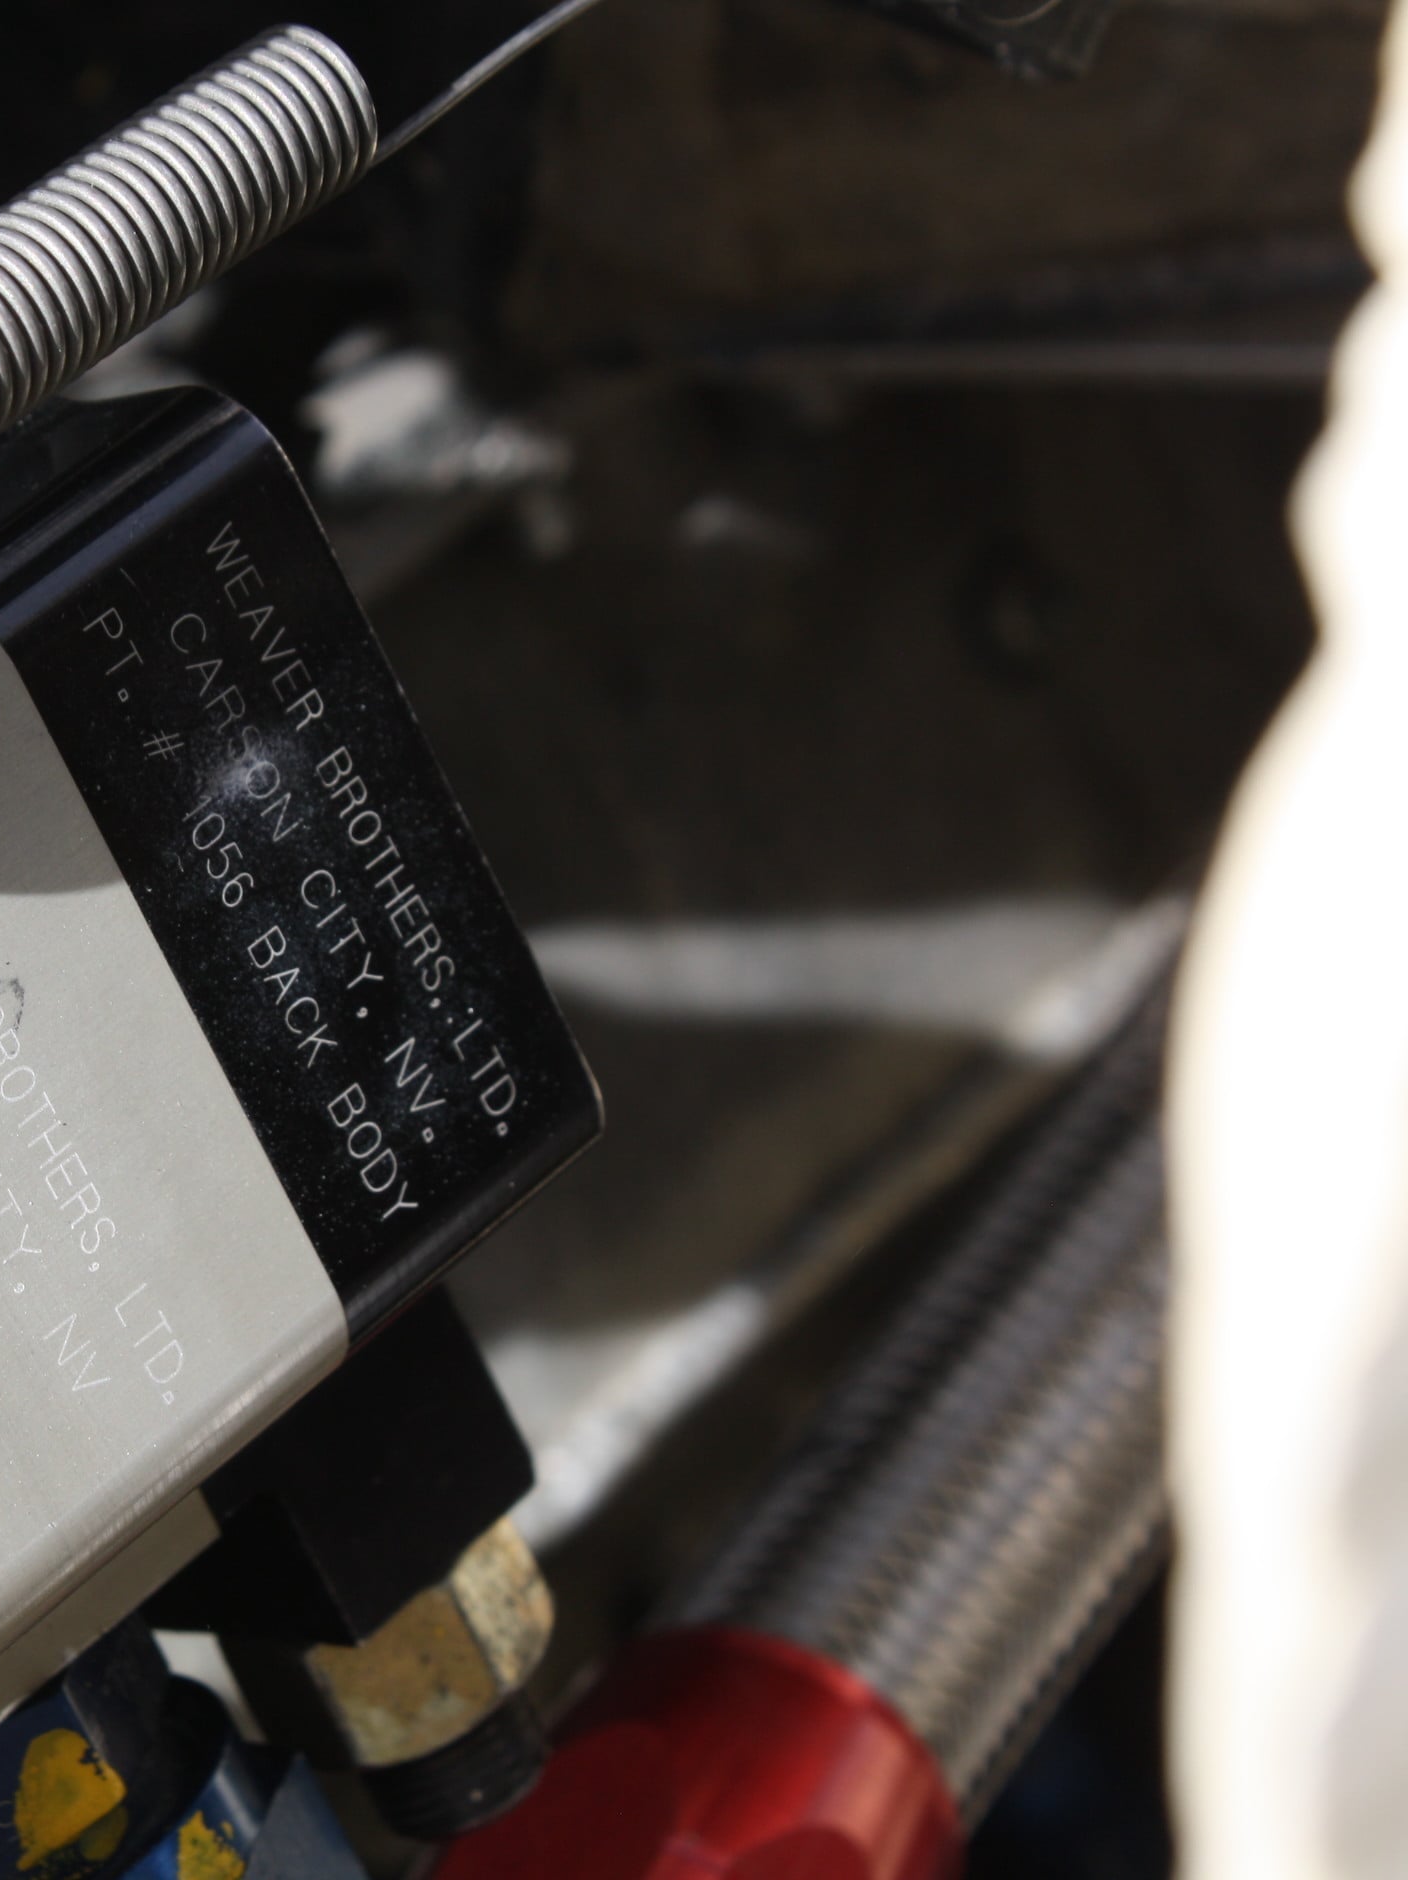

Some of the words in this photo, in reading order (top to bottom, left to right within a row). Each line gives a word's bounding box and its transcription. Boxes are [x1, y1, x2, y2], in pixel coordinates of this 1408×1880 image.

[83, 607, 144, 703] PT.
[143, 730, 185, 761] #
[183, 793, 254, 908] 1056
[247, 925, 338, 1068] BACK
[327, 1083, 419, 1221] BODY
[171, 613, 301, 842] CARSON
[384, 1036, 446, 1144] NV.
[206, 521, 325, 730] WEAVER
[450, 1019, 518, 1137] LTD.
[43, 1311, 111, 1394] NV
